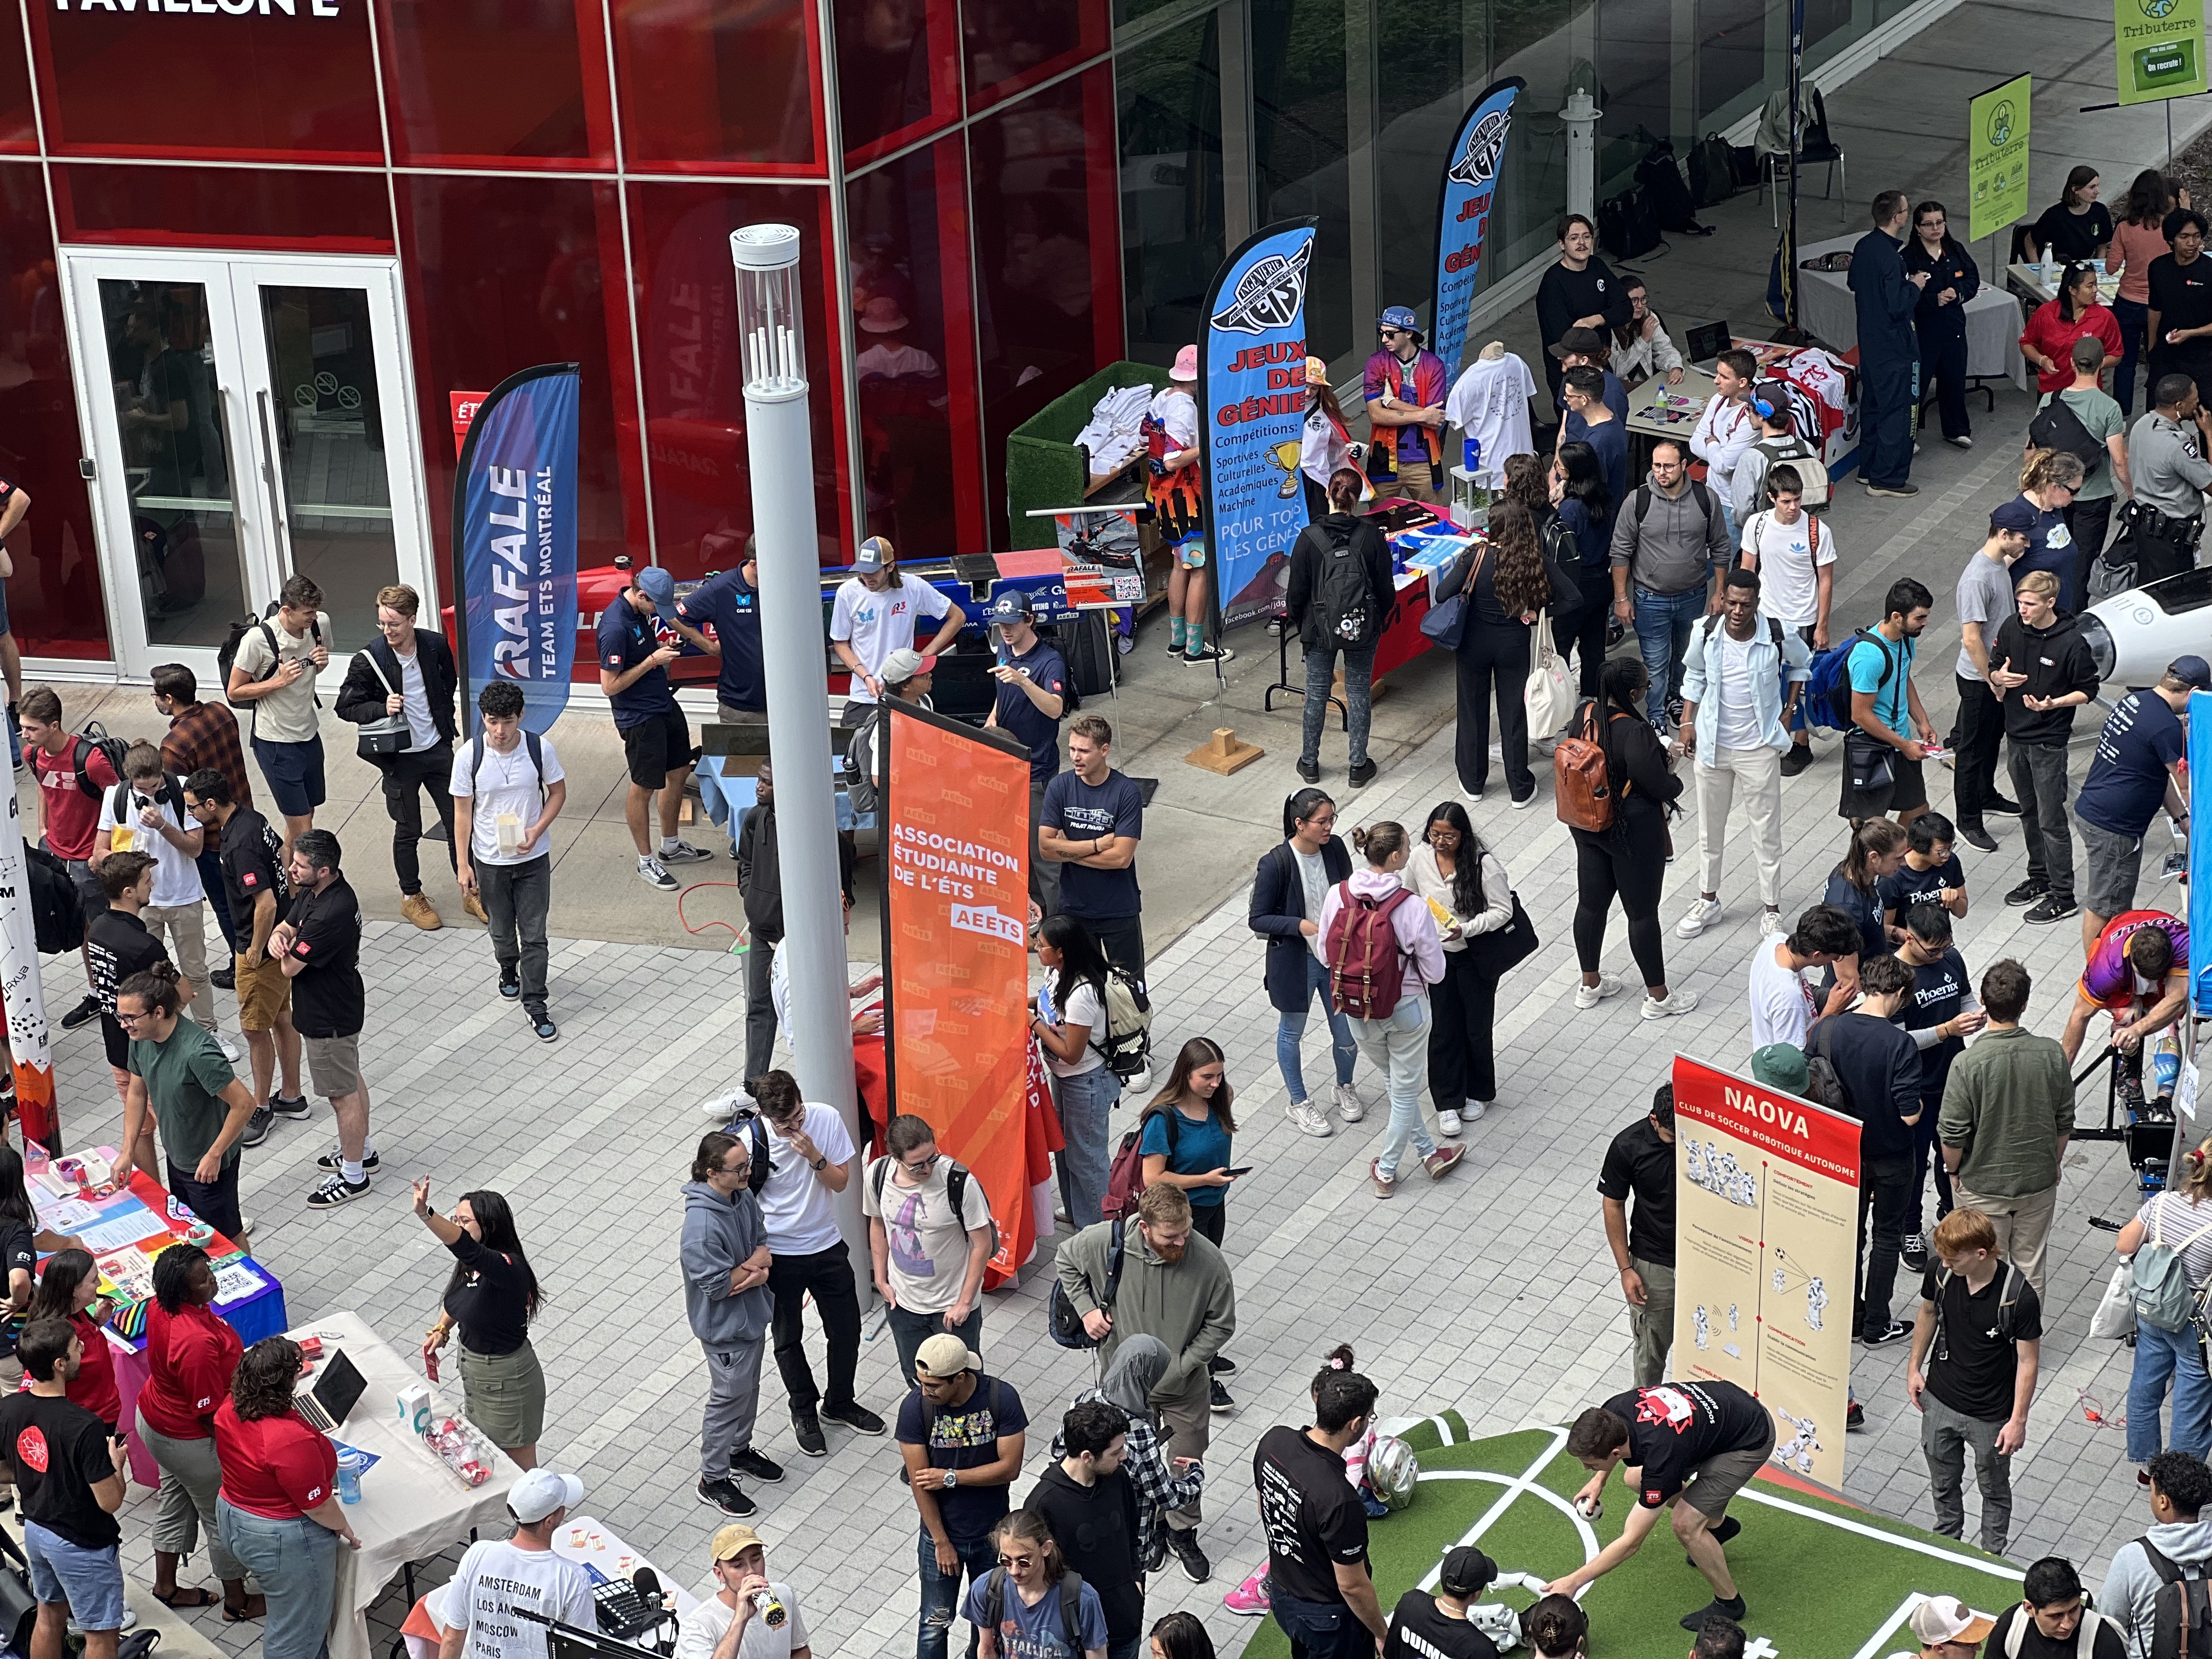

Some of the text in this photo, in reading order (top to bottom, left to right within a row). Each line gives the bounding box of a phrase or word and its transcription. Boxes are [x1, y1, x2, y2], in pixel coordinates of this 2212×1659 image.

[2124, 19, 2196, 37] Tributerre
[2157, 60, 2179, 70] recrute
[1975, 140, 2024, 170] Tributerre
[1228, 340, 1306, 372] JEUX
[1268, 364, 1306, 390] DE
[458, 401, 482, 419] ÉT
[1217, 391, 1306, 426] GÉNIE
[1216, 424, 1298, 448] Compétitions:
[1216, 450, 1259, 469] Sportives
[1217, 464, 1266, 483] Culturelles
[1218, 476, 1279, 499] Académiques
[1219, 497, 1256, 515] Machine
[1221, 516, 1265, 541] POUR
[1225, 541, 1251, 561] LES
[489, 466, 531, 679] RAFALE
[534, 466, 556, 678] TEAM ETS MONTRÉAL
[893, 823, 1018, 873] ASSOCIATION
[894, 841, 997, 885] ÉTUDIANTE
[894, 864, 974, 899] DE L'ÉTS
[956, 910, 1020, 939] AEETS
[1914, 981, 1959, 1005] Phoenix
[1724, 1086, 1809, 1139] NAOVA
[1679, 1101, 1855, 1178] CLUB DE SOCCER ROBOTIQUE AUTONOME
[1773, 1169, 1813, 1189] COMPORTEMENT
[1738, 1234, 1754, 1245] VISION
[1767, 1324, 1806, 1347] COMMUNICATION
[1700, 1401, 1715, 1424] soccer
[478, 1575, 541, 1600] AMSTERDAM
[477, 1598, 494, 1613] LOS
[476, 1620, 518, 1637] MOSCOW
[476, 1641, 501, 1659] PARIS
